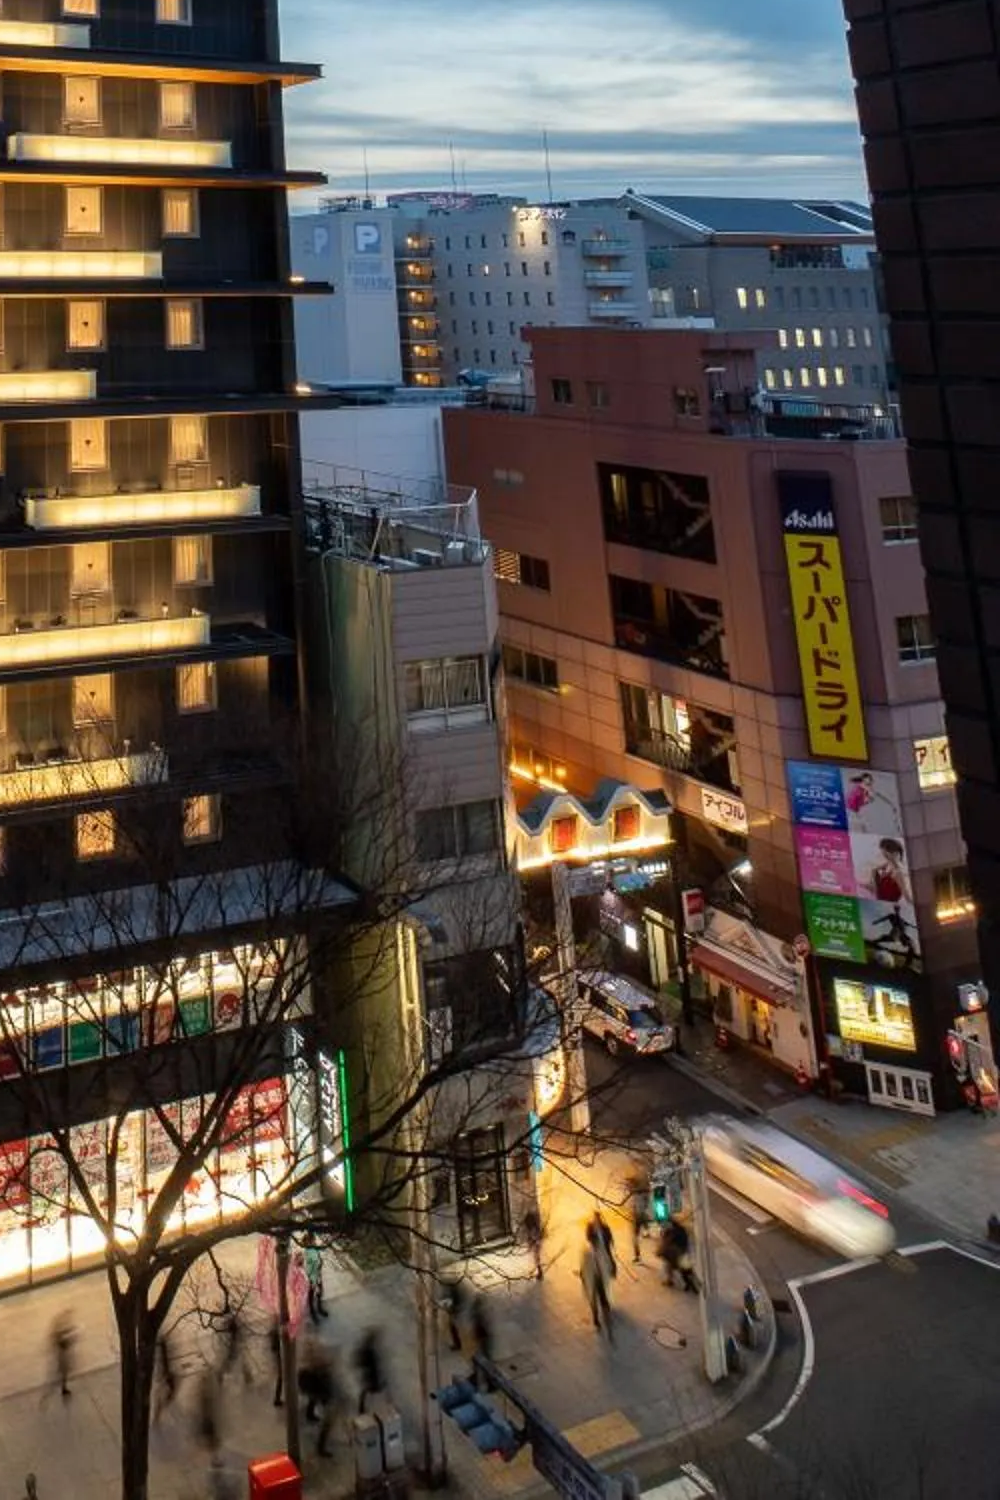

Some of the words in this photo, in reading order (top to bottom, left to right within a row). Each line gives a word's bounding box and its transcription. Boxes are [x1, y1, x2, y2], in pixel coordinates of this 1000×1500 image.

[356, 225, 379, 252] P
[784, 509, 834, 530] Asahi
[798, 541, 849, 742] スーパードライ
[703, 793, 744, 821] アイフル
